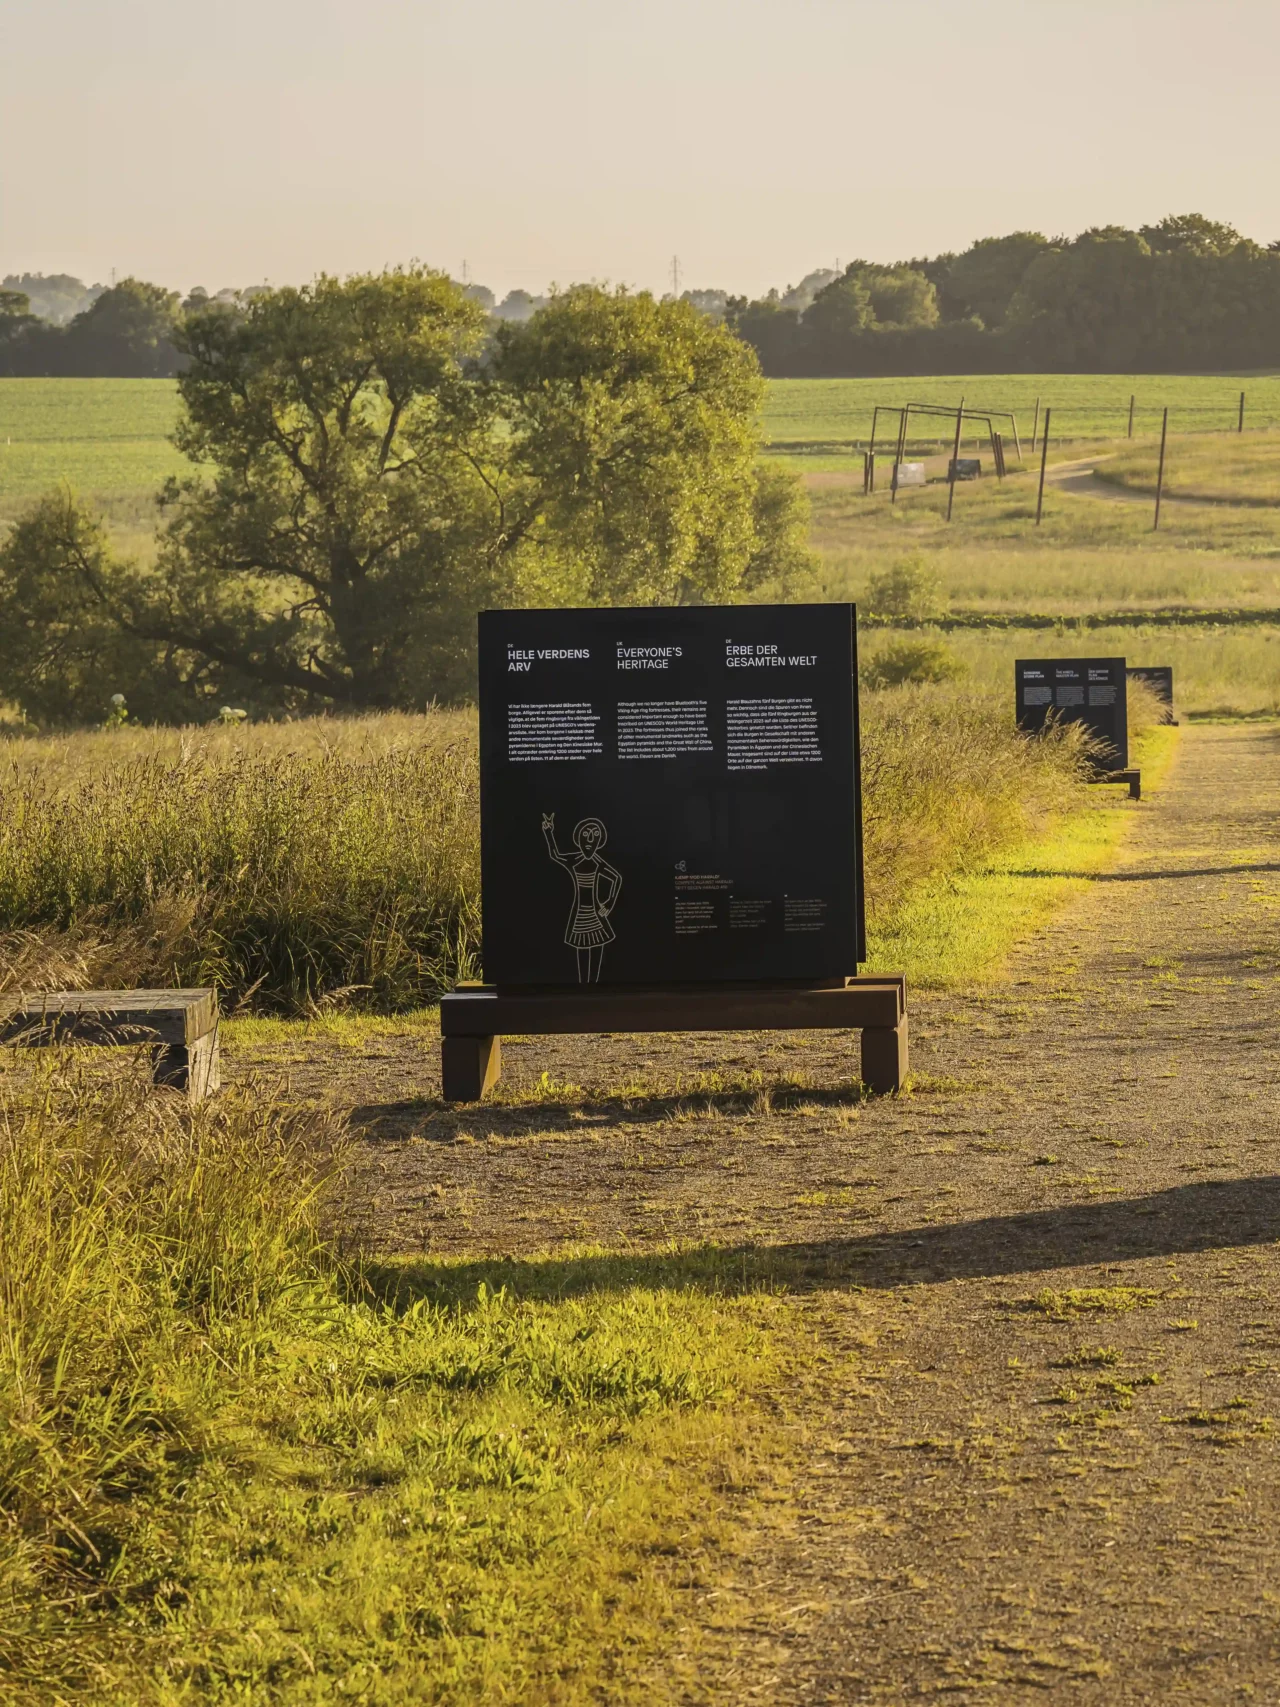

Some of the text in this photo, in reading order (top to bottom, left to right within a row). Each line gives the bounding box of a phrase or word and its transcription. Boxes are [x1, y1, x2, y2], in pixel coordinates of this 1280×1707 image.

[508, 649, 590, 660] HELE VERDENS
[617, 647, 682, 657] EVERYONE'S
[726, 645, 777, 655] ERBE DER
[508, 662, 531, 671] ARV
[618, 659, 668, 669] HERITAGE
[726, 656, 817, 667] GESAMTEN WELT
